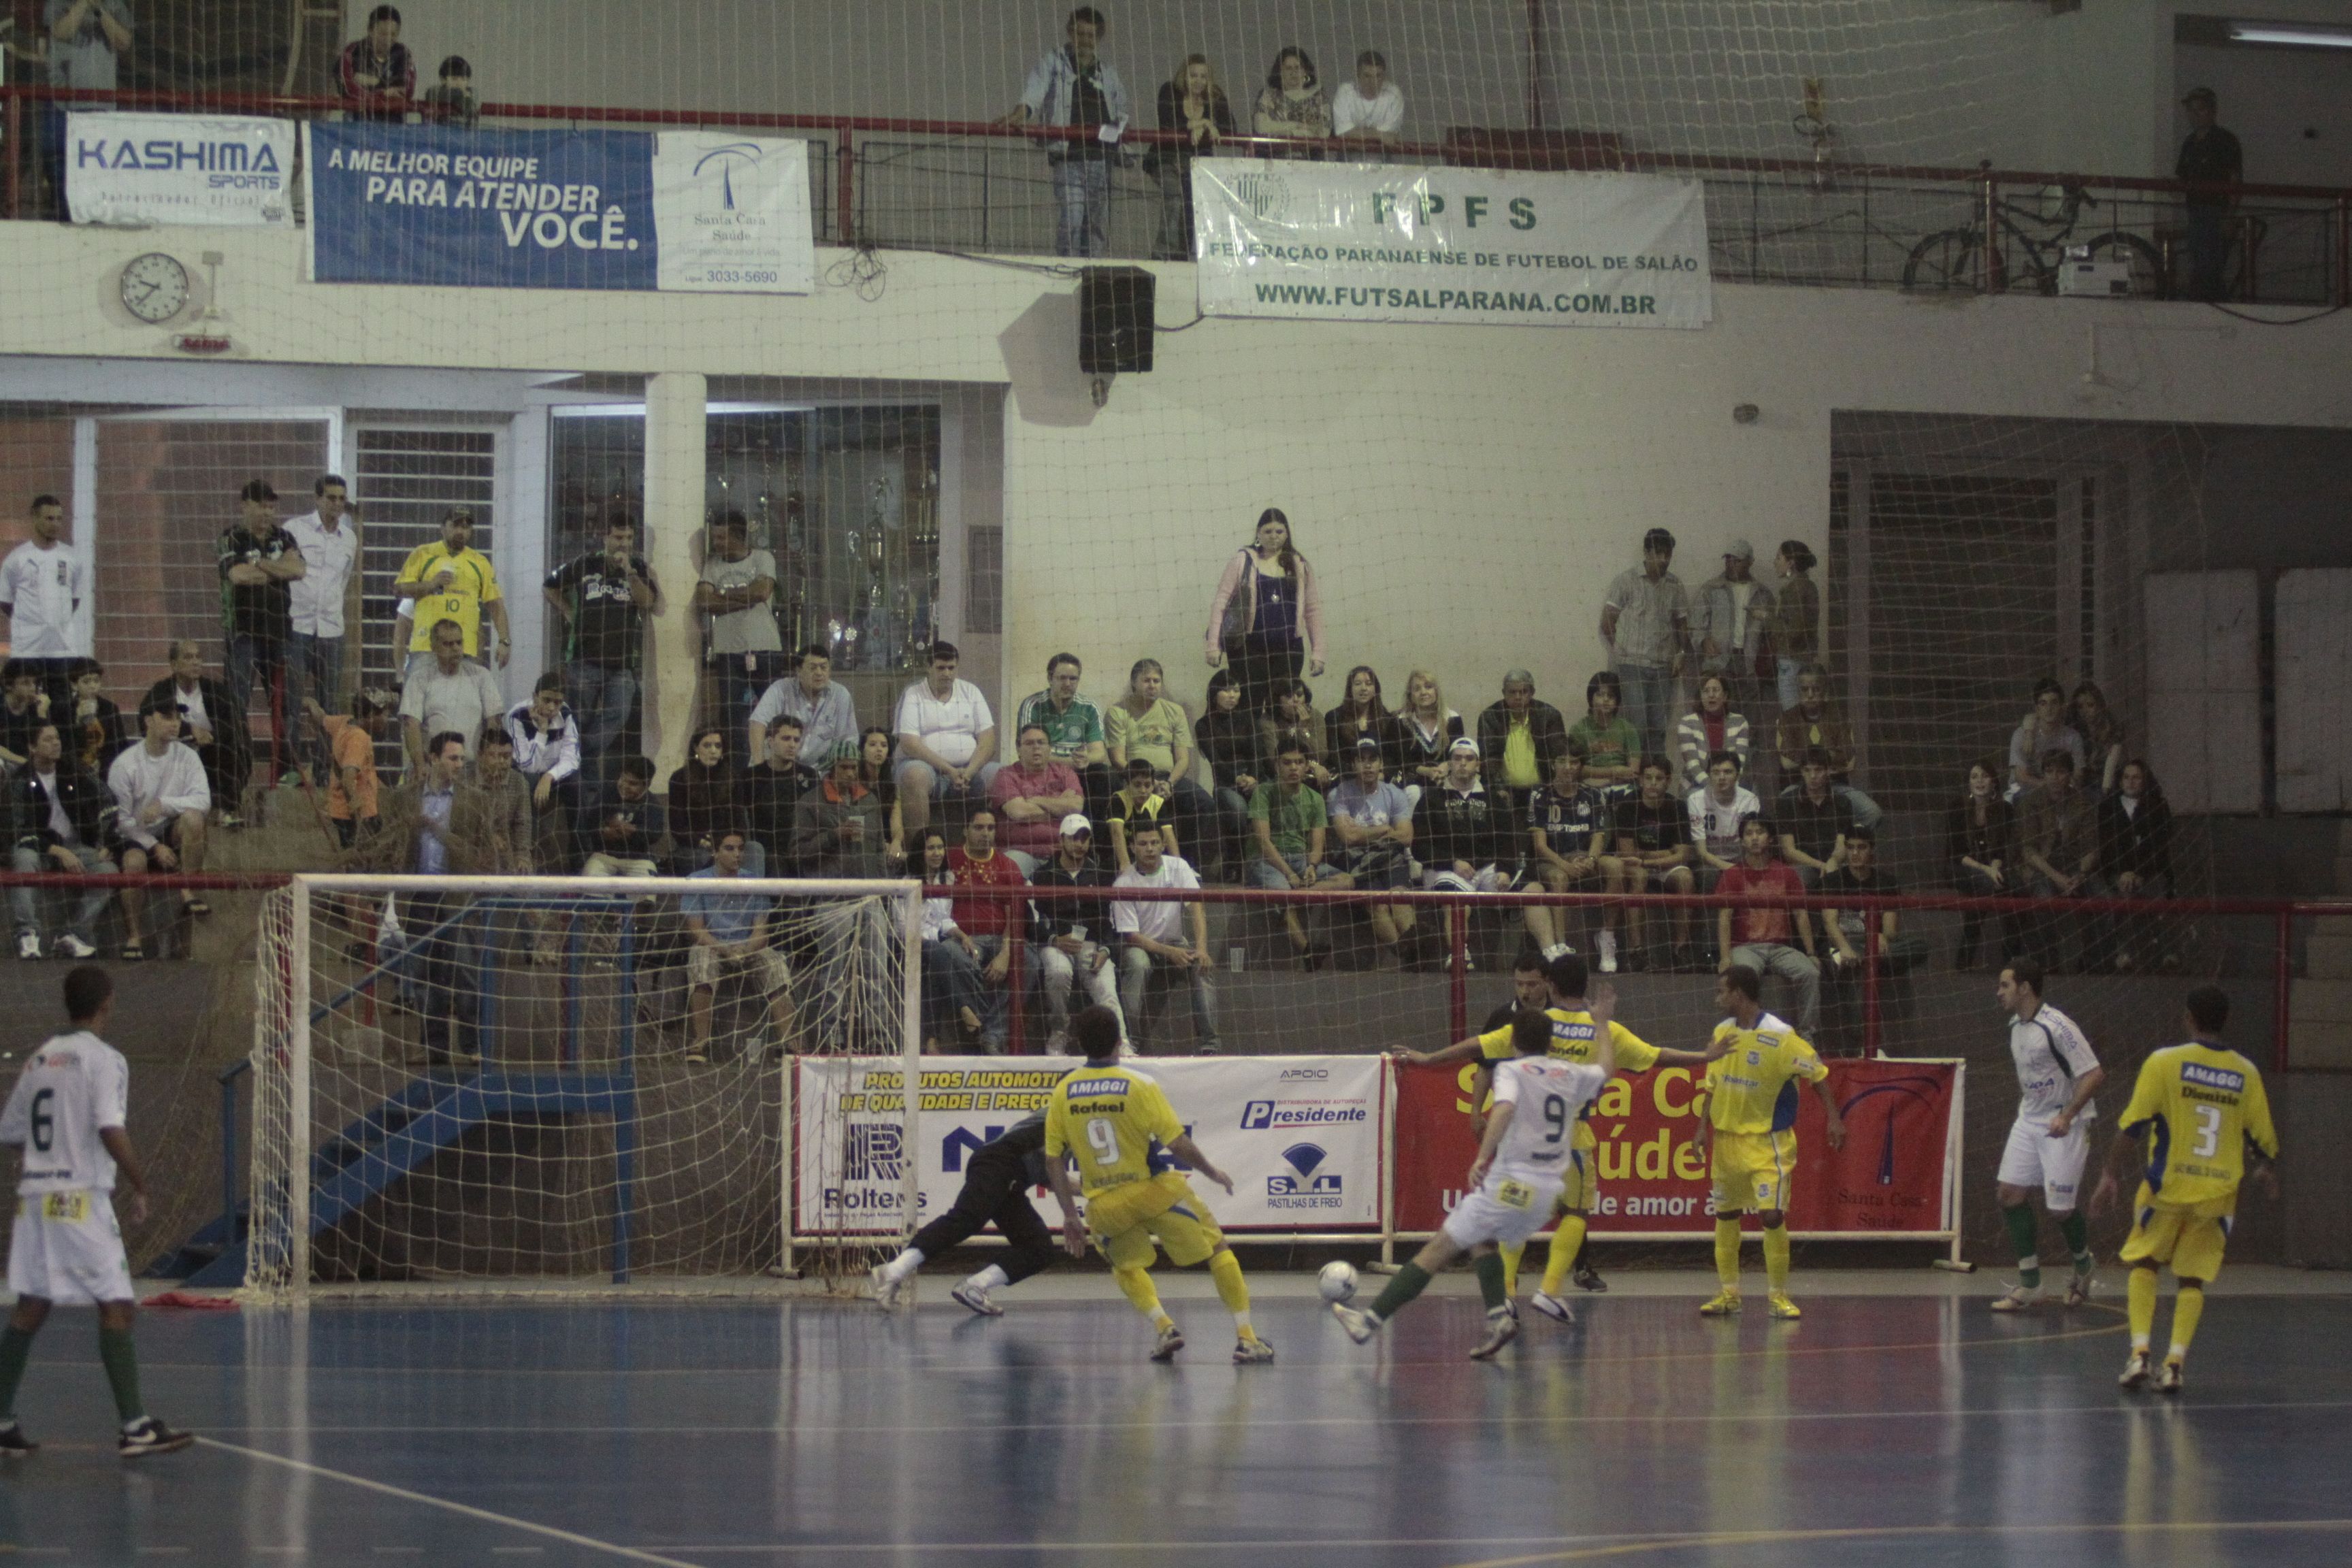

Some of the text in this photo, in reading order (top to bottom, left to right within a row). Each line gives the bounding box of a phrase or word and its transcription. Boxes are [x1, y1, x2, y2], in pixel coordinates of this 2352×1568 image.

[78, 139, 280, 172] KASHIMA
[329, 148, 538, 180] A MELHOR EQUIPE
[208, 175, 280, 190] SPORTS
[366, 176, 600, 213] PARA ATENDER
[500, 204, 638, 251] VOCÊ.
[694, 213, 732, 225] Santa
[1336, 247, 1467, 265] PARANAENSE
[1475, 252, 1500, 267] DE
[1507, 254, 1597, 270] FUTEBOL
[1603, 256, 1629, 270] DE
[1635, 254, 1698, 272] SALÃO
[707, 270, 777, 282] 3033-5690
[1255, 283, 1656, 314] WWW.FUTSALPARANA.COM.BR
[446, 599, 460, 612] 10
[1552, 1022, 1594, 1038] MAGGI
[863, 1071, 963, 1089] PROUTOS
[1280, 1070, 1328, 1079] APOIO
[2184, 1065, 2243, 1089] AMAGGI
[1069, 1080, 1126, 1096] AMAGGI
[975, 1094, 993, 1110] E
[1070, 1101, 1125, 1115] Rafael
[31, 1088, 55, 1152] 6
[1243, 1101, 1367, 1128] Presidente
[1544, 1094, 1565, 1143] 9
[2192, 1104, 2221, 1157] 3
[1087, 1117, 1120, 1166] 9
[1268, 1197, 1342, 1209] PASTILHAS DE FREIO
[1625, 1198, 1697, 1215] amor
